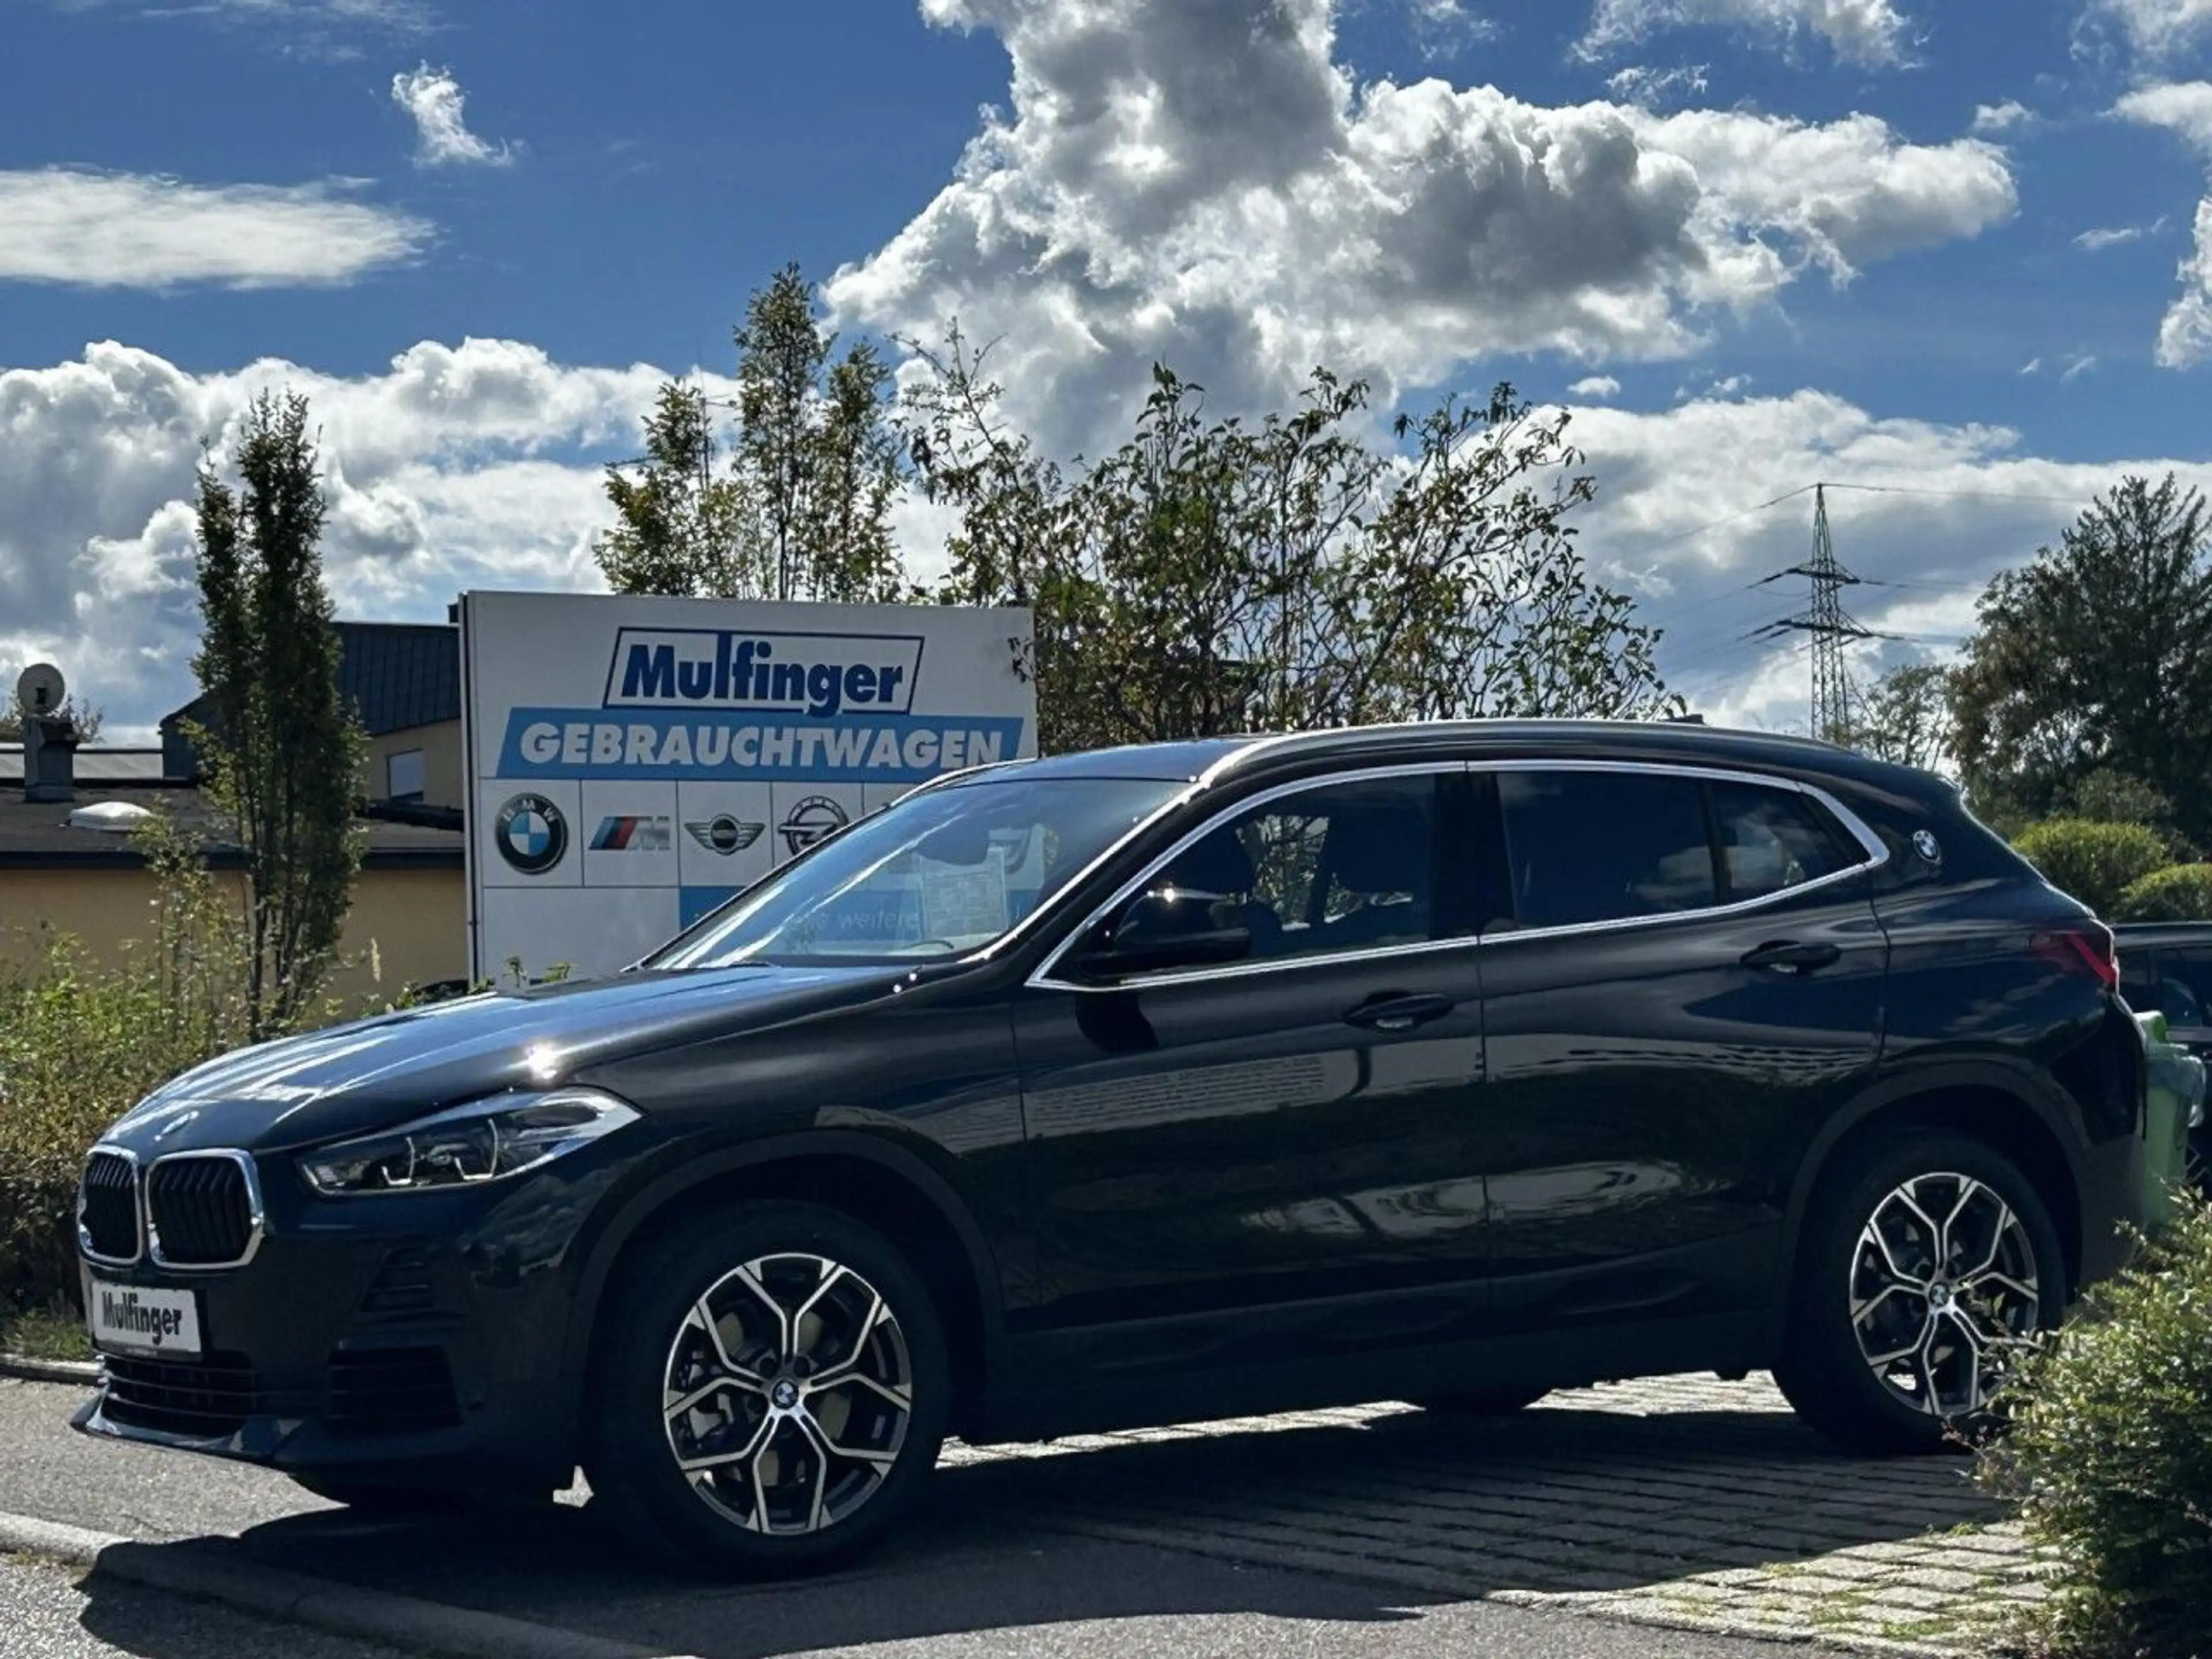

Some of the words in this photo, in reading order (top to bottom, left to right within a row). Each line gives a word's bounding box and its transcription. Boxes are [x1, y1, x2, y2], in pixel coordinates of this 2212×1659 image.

[622, 631, 903, 718] Mulfinger
[521, 722, 1002, 768] GEBRAUCHTWAGEN
[102, 1290, 182, 1345] Mulfinger
